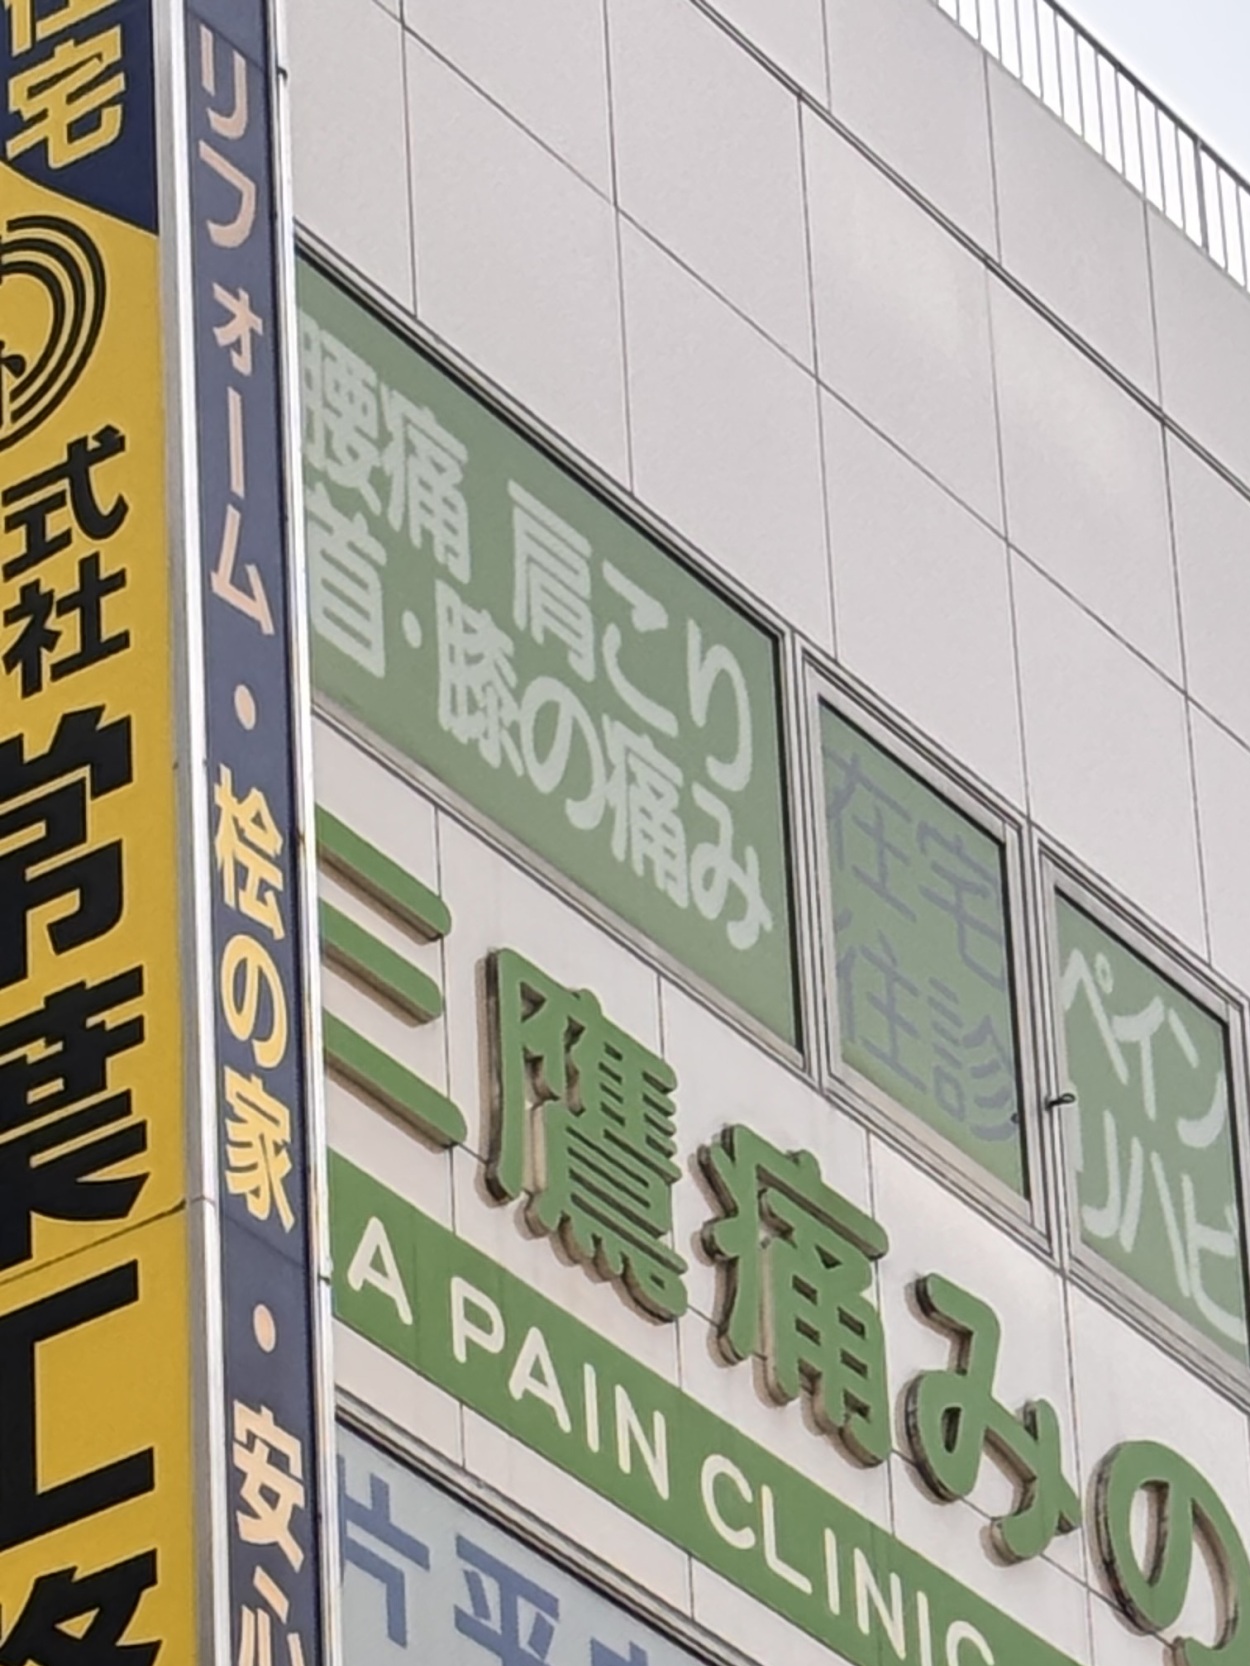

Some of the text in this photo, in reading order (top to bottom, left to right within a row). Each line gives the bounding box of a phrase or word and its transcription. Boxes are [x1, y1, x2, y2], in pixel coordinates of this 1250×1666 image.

[301, 312, 753, 795] 腰痛 肩こり
[304, 480, 775, 952] 首・膝の痛み
[448, 1284, 670, 1502] PAIN
